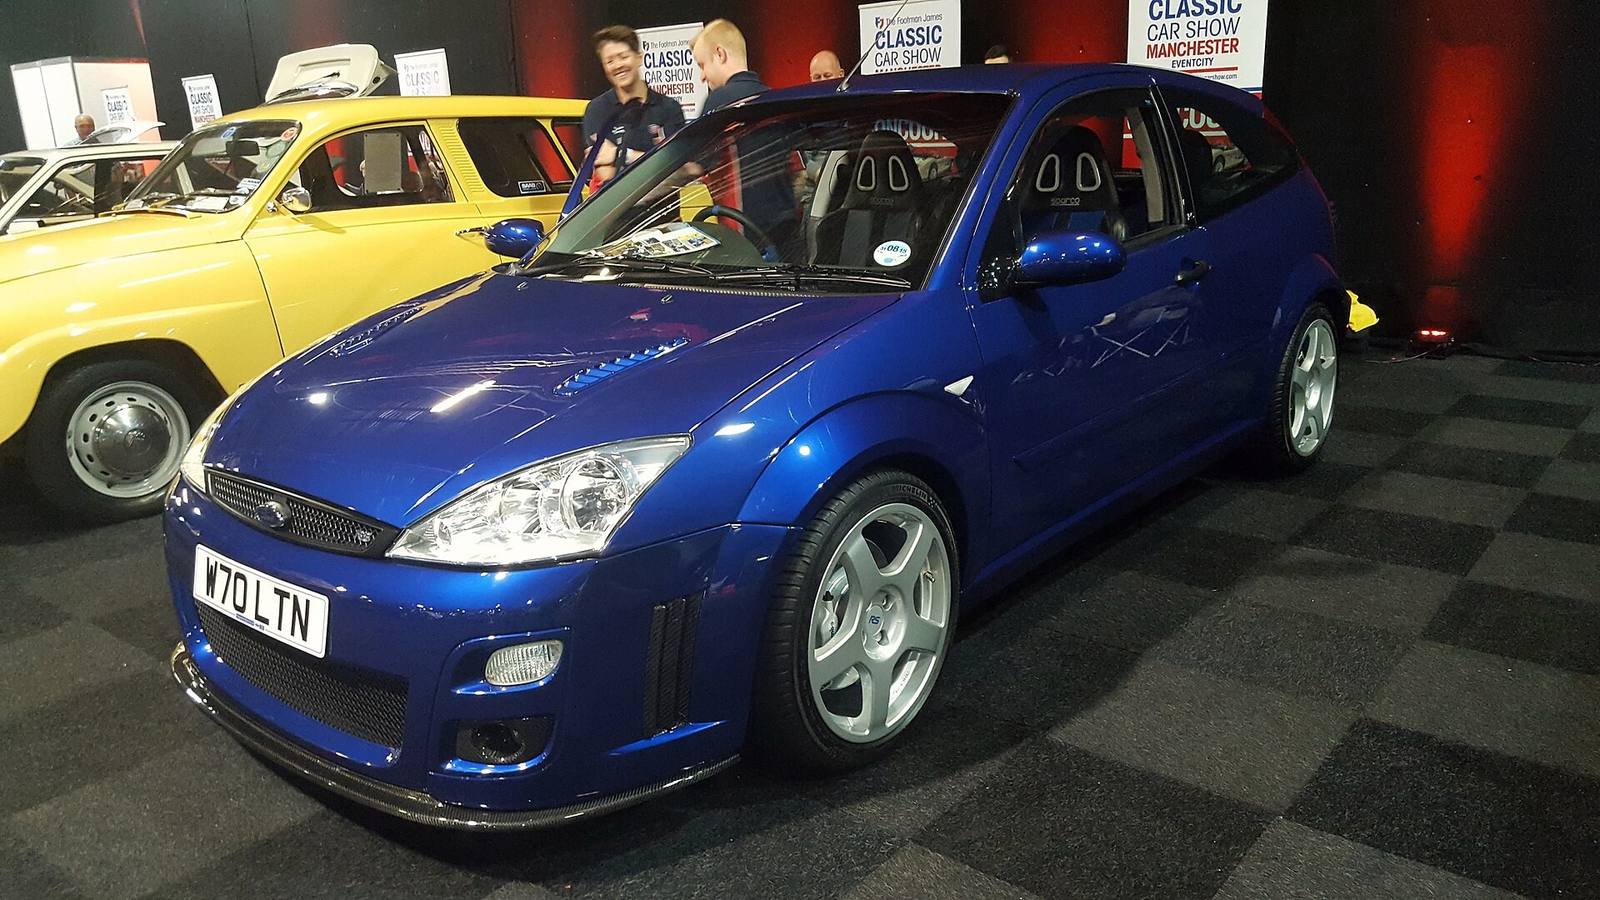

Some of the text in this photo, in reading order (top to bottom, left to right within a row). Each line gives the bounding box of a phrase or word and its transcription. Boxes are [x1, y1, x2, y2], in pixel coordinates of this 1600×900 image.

[897, 16, 922, 24] Footman
[923, 13, 943, 21] James
[1148, 0, 1242, 20] CLASSIC
[875, 25, 942, 49] CLASSIC
[1147, 16, 1240, 41] CAR SHOW
[874, 47, 941, 67] CAR SHOW
[1146, 38, 1239, 59] MANCHESTER
[644, 49, 693, 69] CLASSIC
[1171, 57, 1214, 68] EVENTCITY
[644, 68, 694, 85] CAR SHOW
[206, 556, 310, 642] W70 LTN
[868, 615, 881, 625] RS
